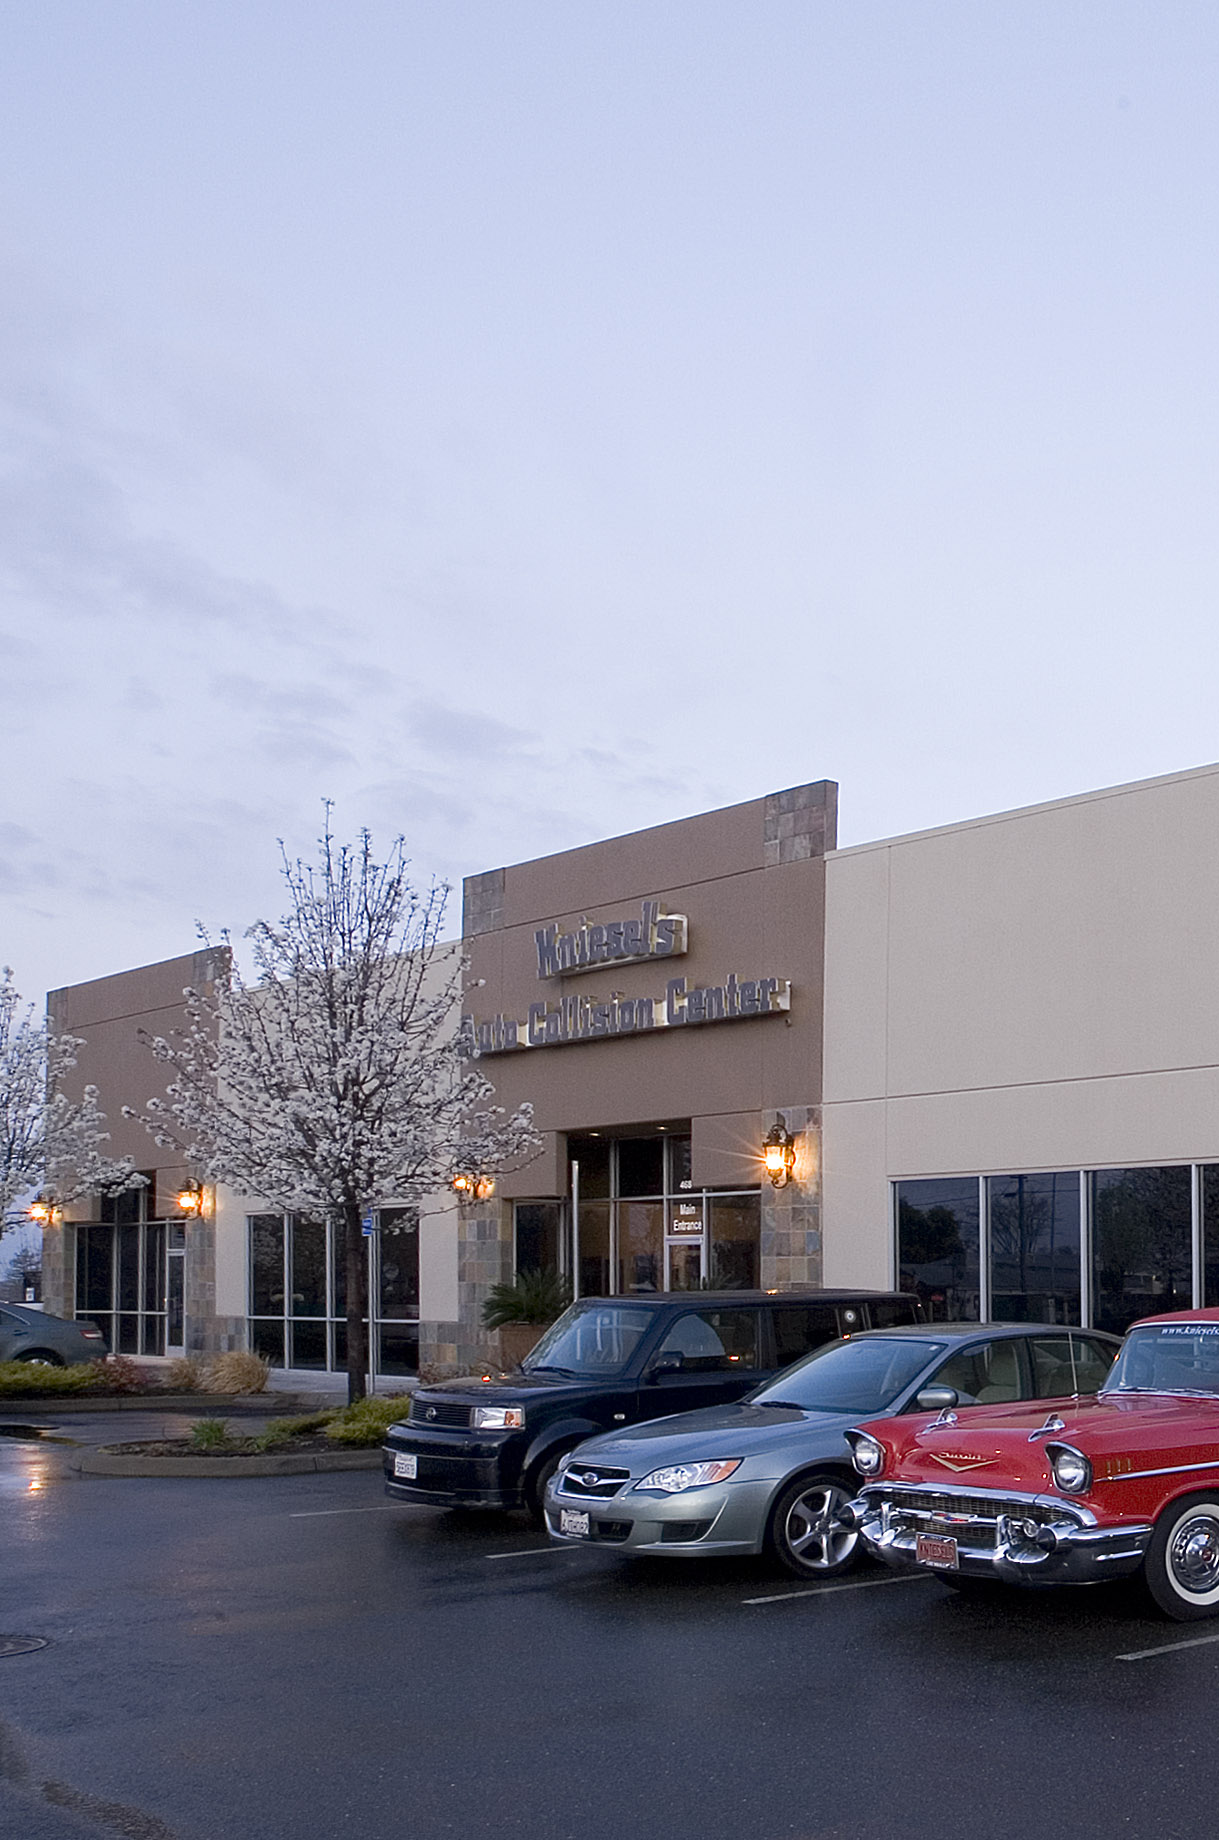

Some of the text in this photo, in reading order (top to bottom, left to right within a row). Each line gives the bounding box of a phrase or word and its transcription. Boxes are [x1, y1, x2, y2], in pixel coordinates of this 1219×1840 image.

[533, 901, 679, 979] Kniesel's
[458, 974, 780, 1057] Auto Collision Center
[673, 1219, 702, 1231] Entrance
[680, 1202, 696, 1215] Main
